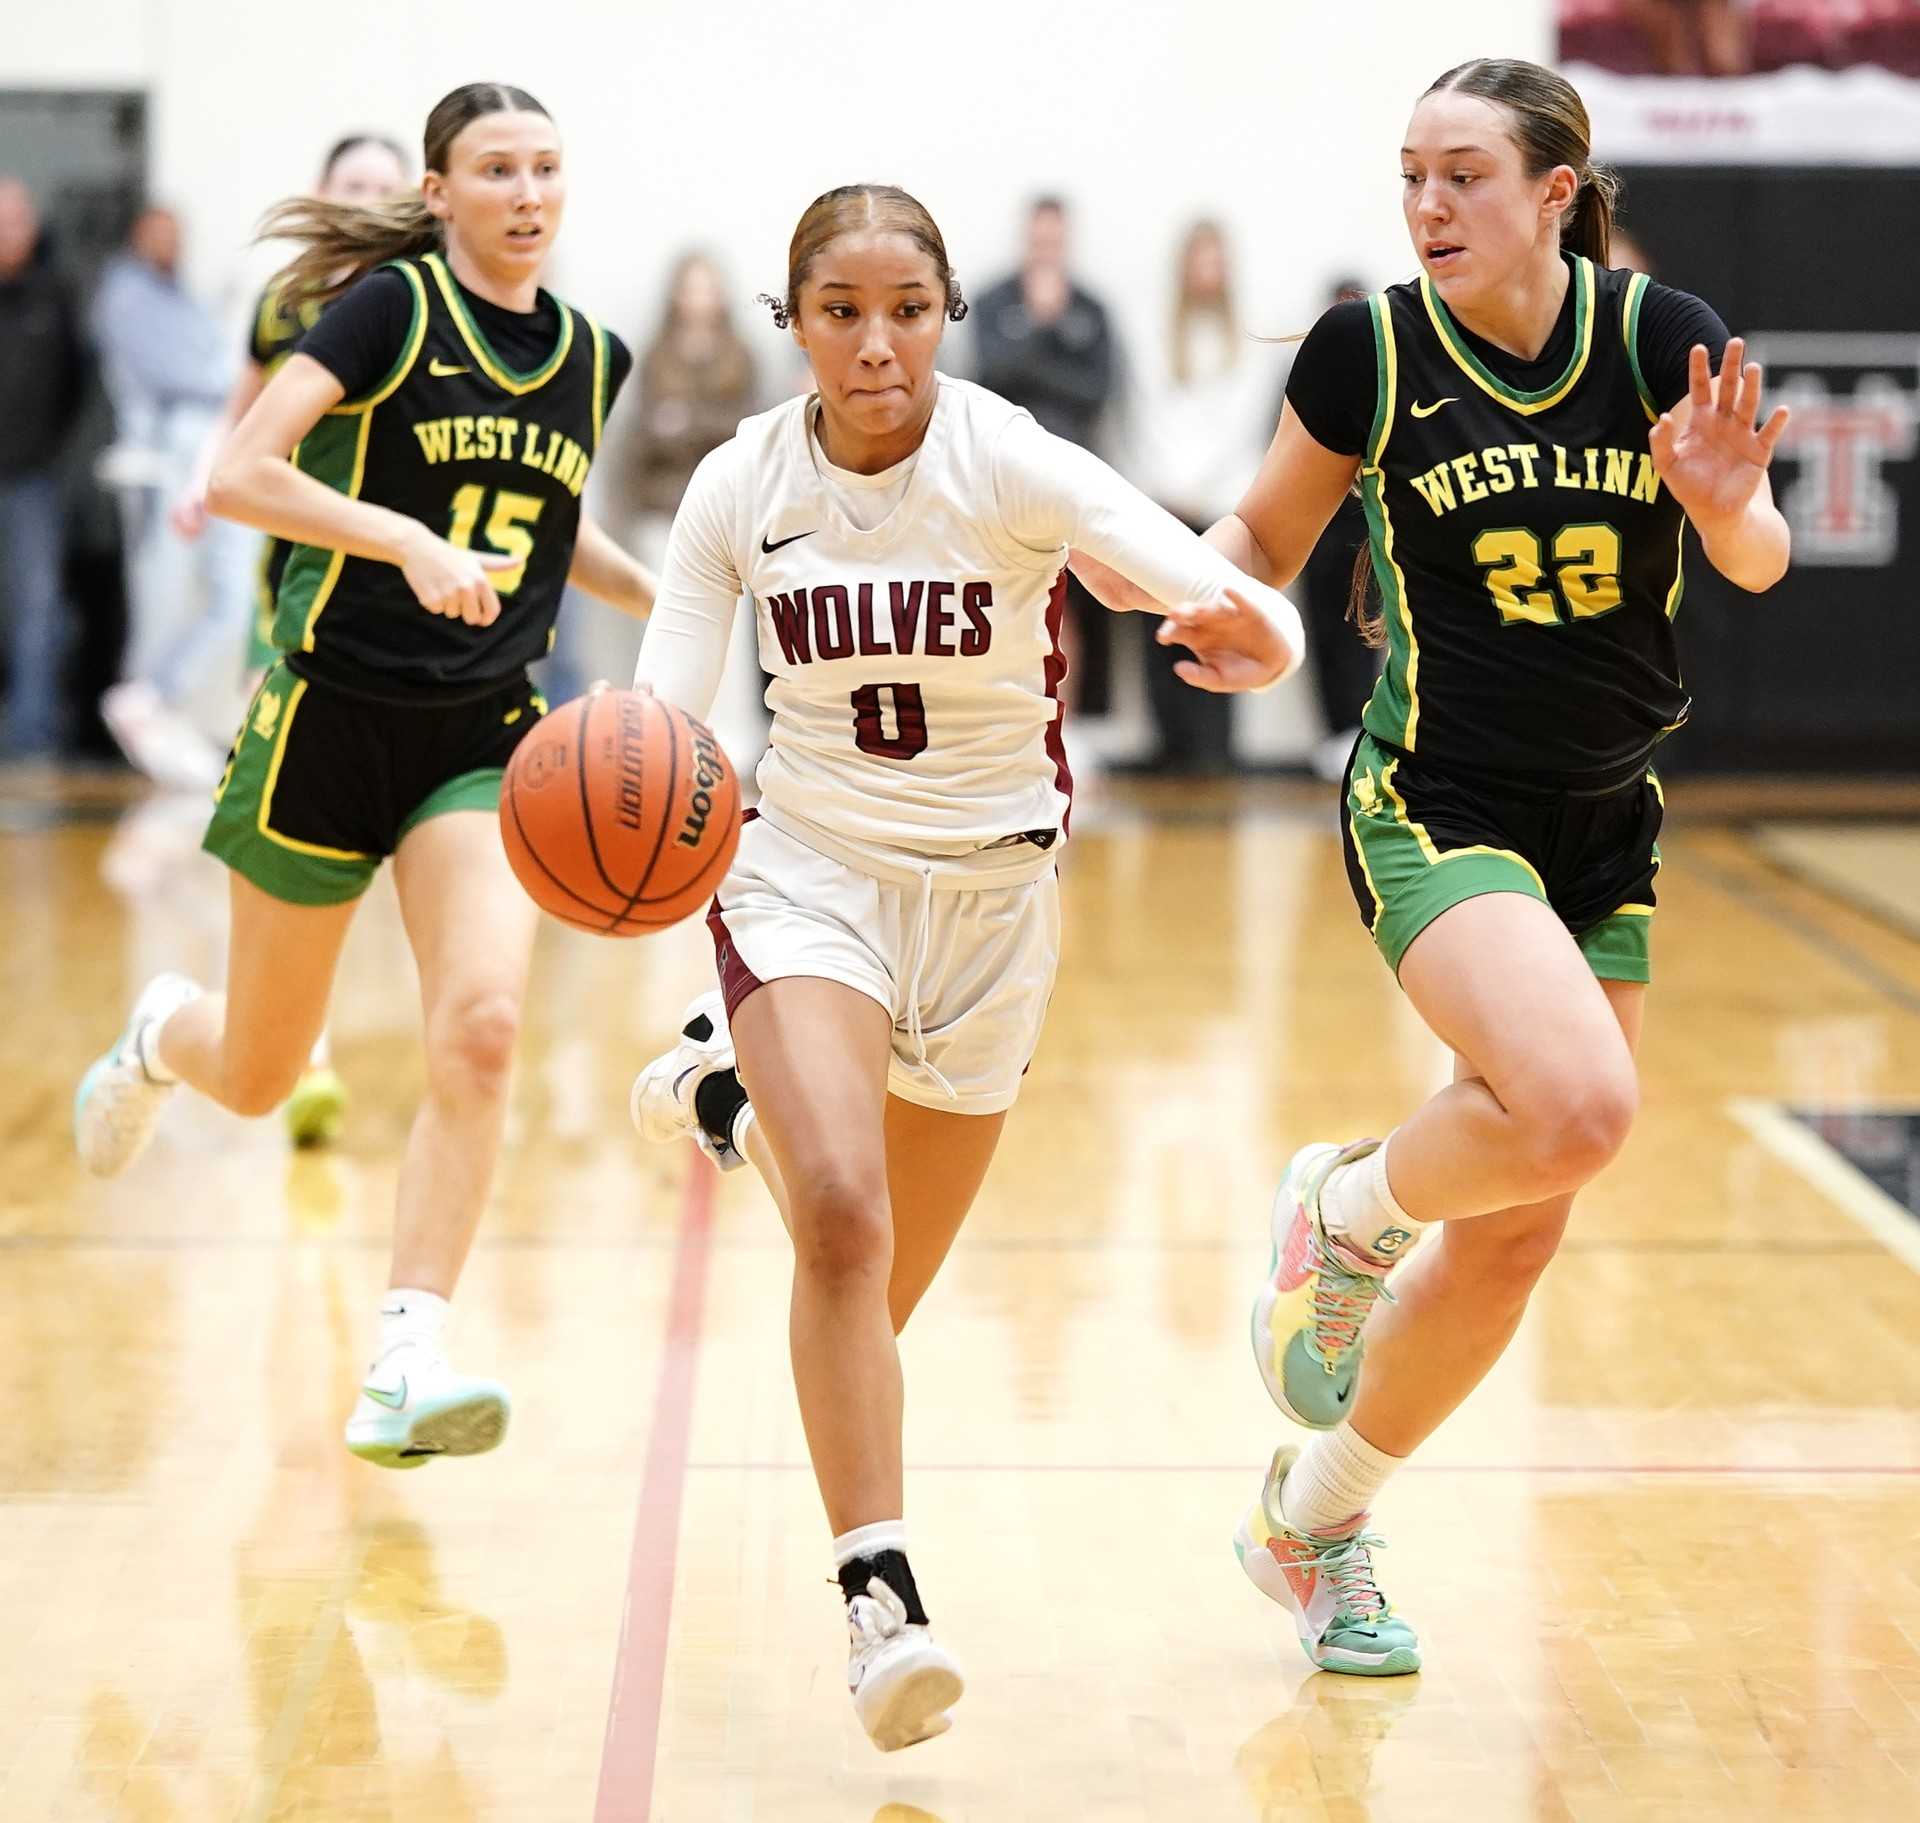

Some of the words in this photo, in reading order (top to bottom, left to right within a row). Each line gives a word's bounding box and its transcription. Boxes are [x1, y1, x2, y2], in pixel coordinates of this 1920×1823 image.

[413, 415, 519, 465] WEST
[1408, 443, 1540, 518] WEST
[1552, 443, 1662, 505] LINN
[447, 482, 546, 597] 15
[1470, 520, 1626, 627] 22
[768, 580, 993, 665] WOLVES
[850, 683, 928, 760] 0
